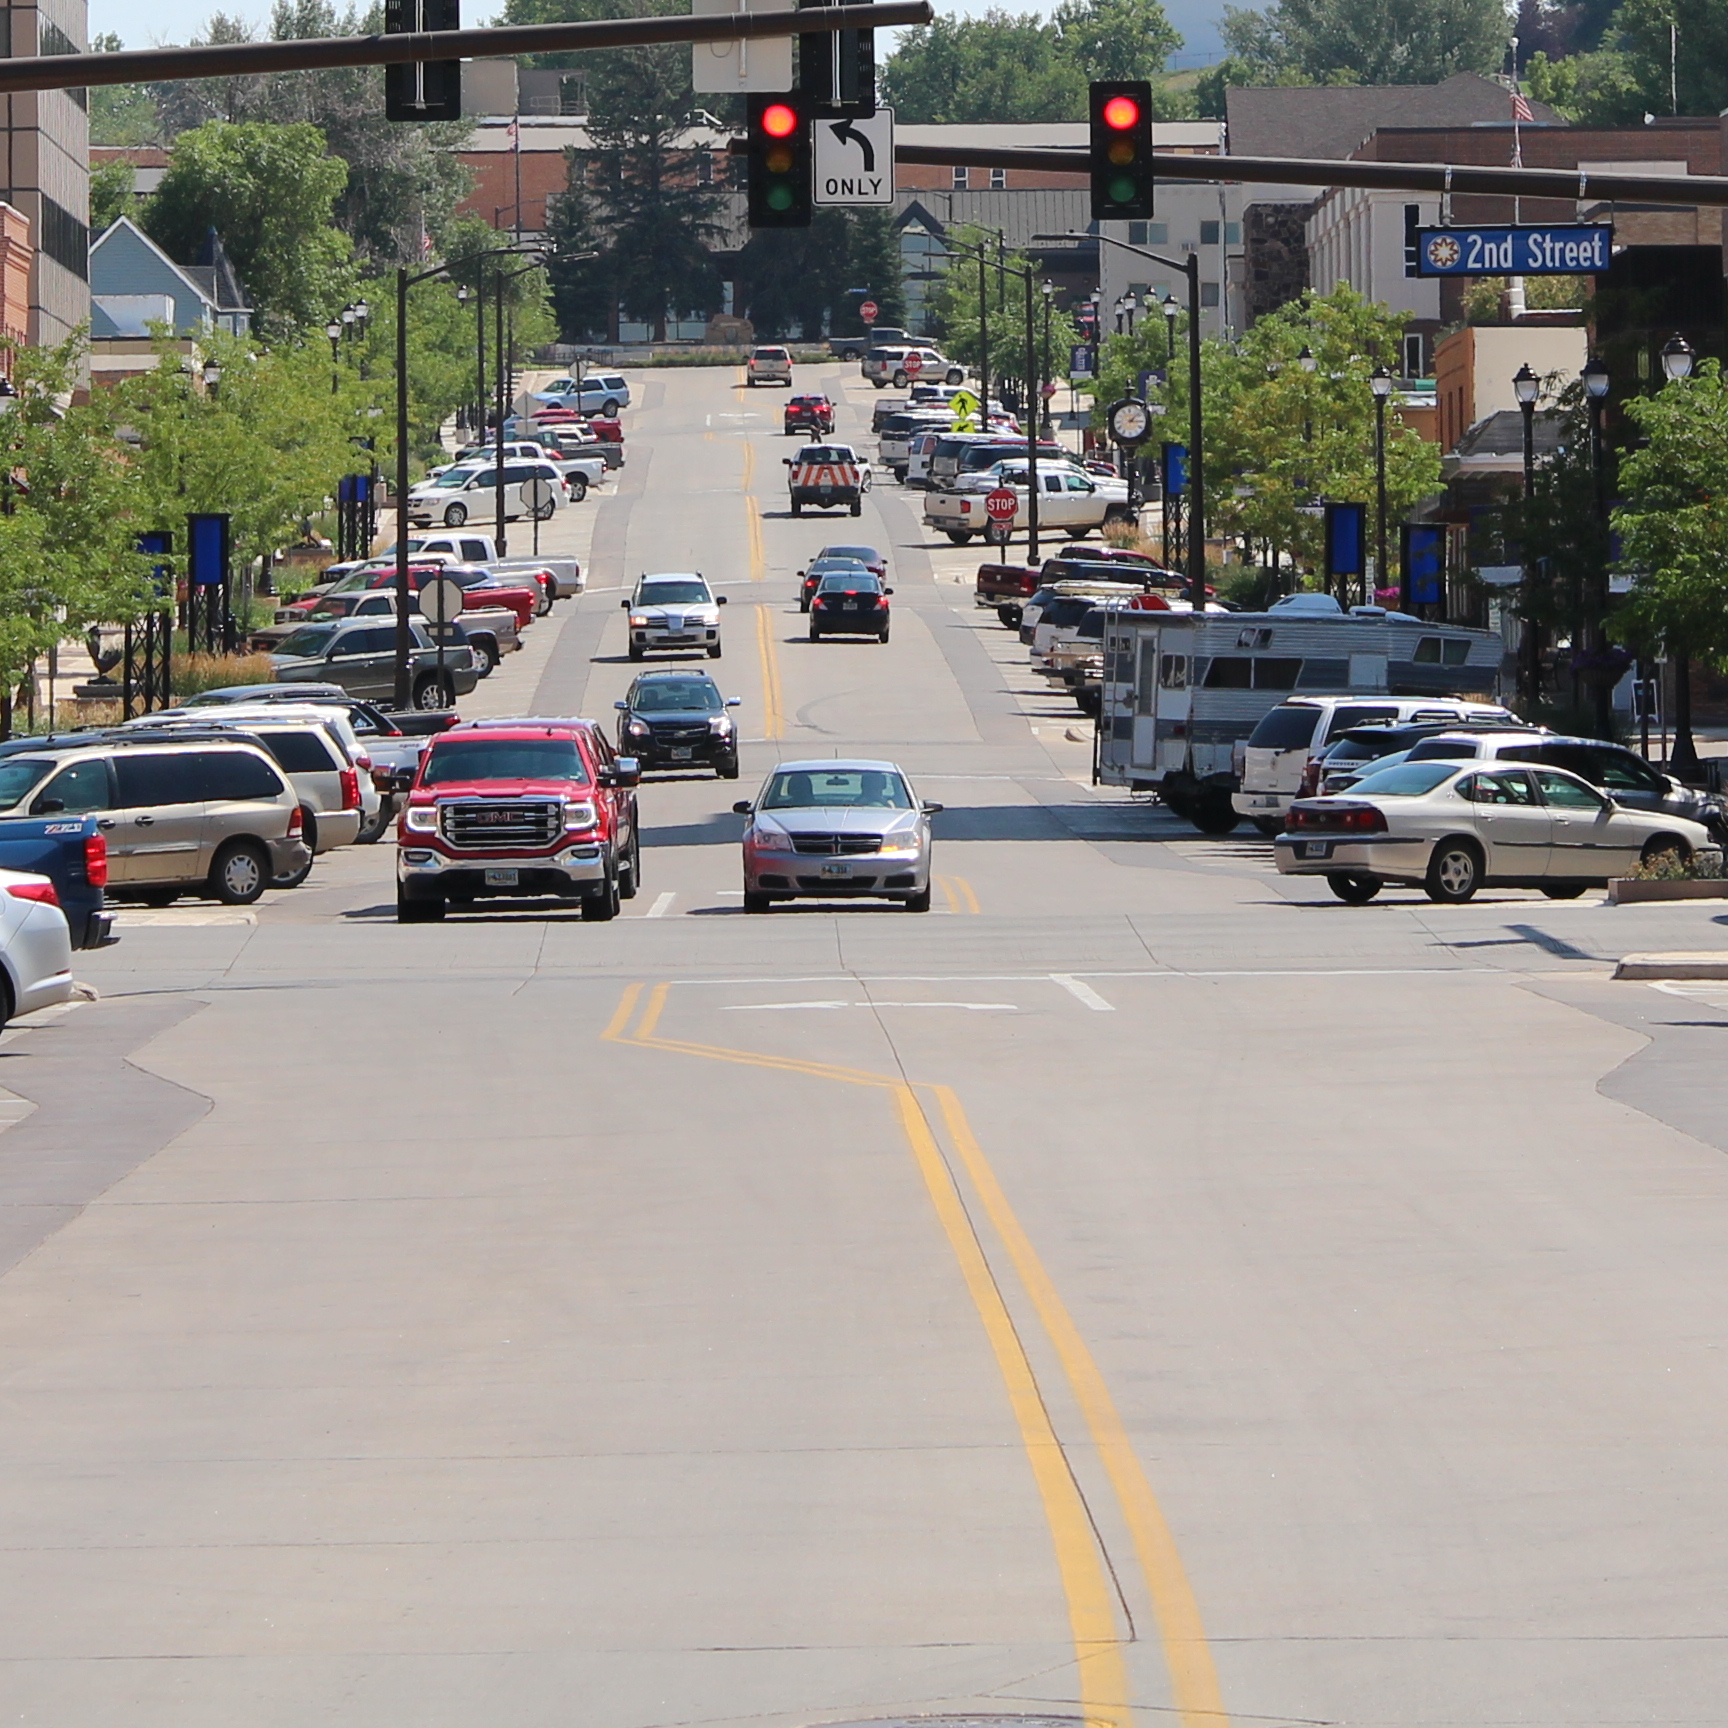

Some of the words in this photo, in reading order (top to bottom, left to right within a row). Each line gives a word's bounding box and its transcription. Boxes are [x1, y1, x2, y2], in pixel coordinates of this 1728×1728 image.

[825, 178, 882, 195] ONLY
[1466, 234, 1513, 269] 2nd
[1527, 232, 1604, 268] Street
[904, 360, 921, 369] STOP
[987, 498, 1015, 511] STOP
[476, 811, 524, 824] GMC
